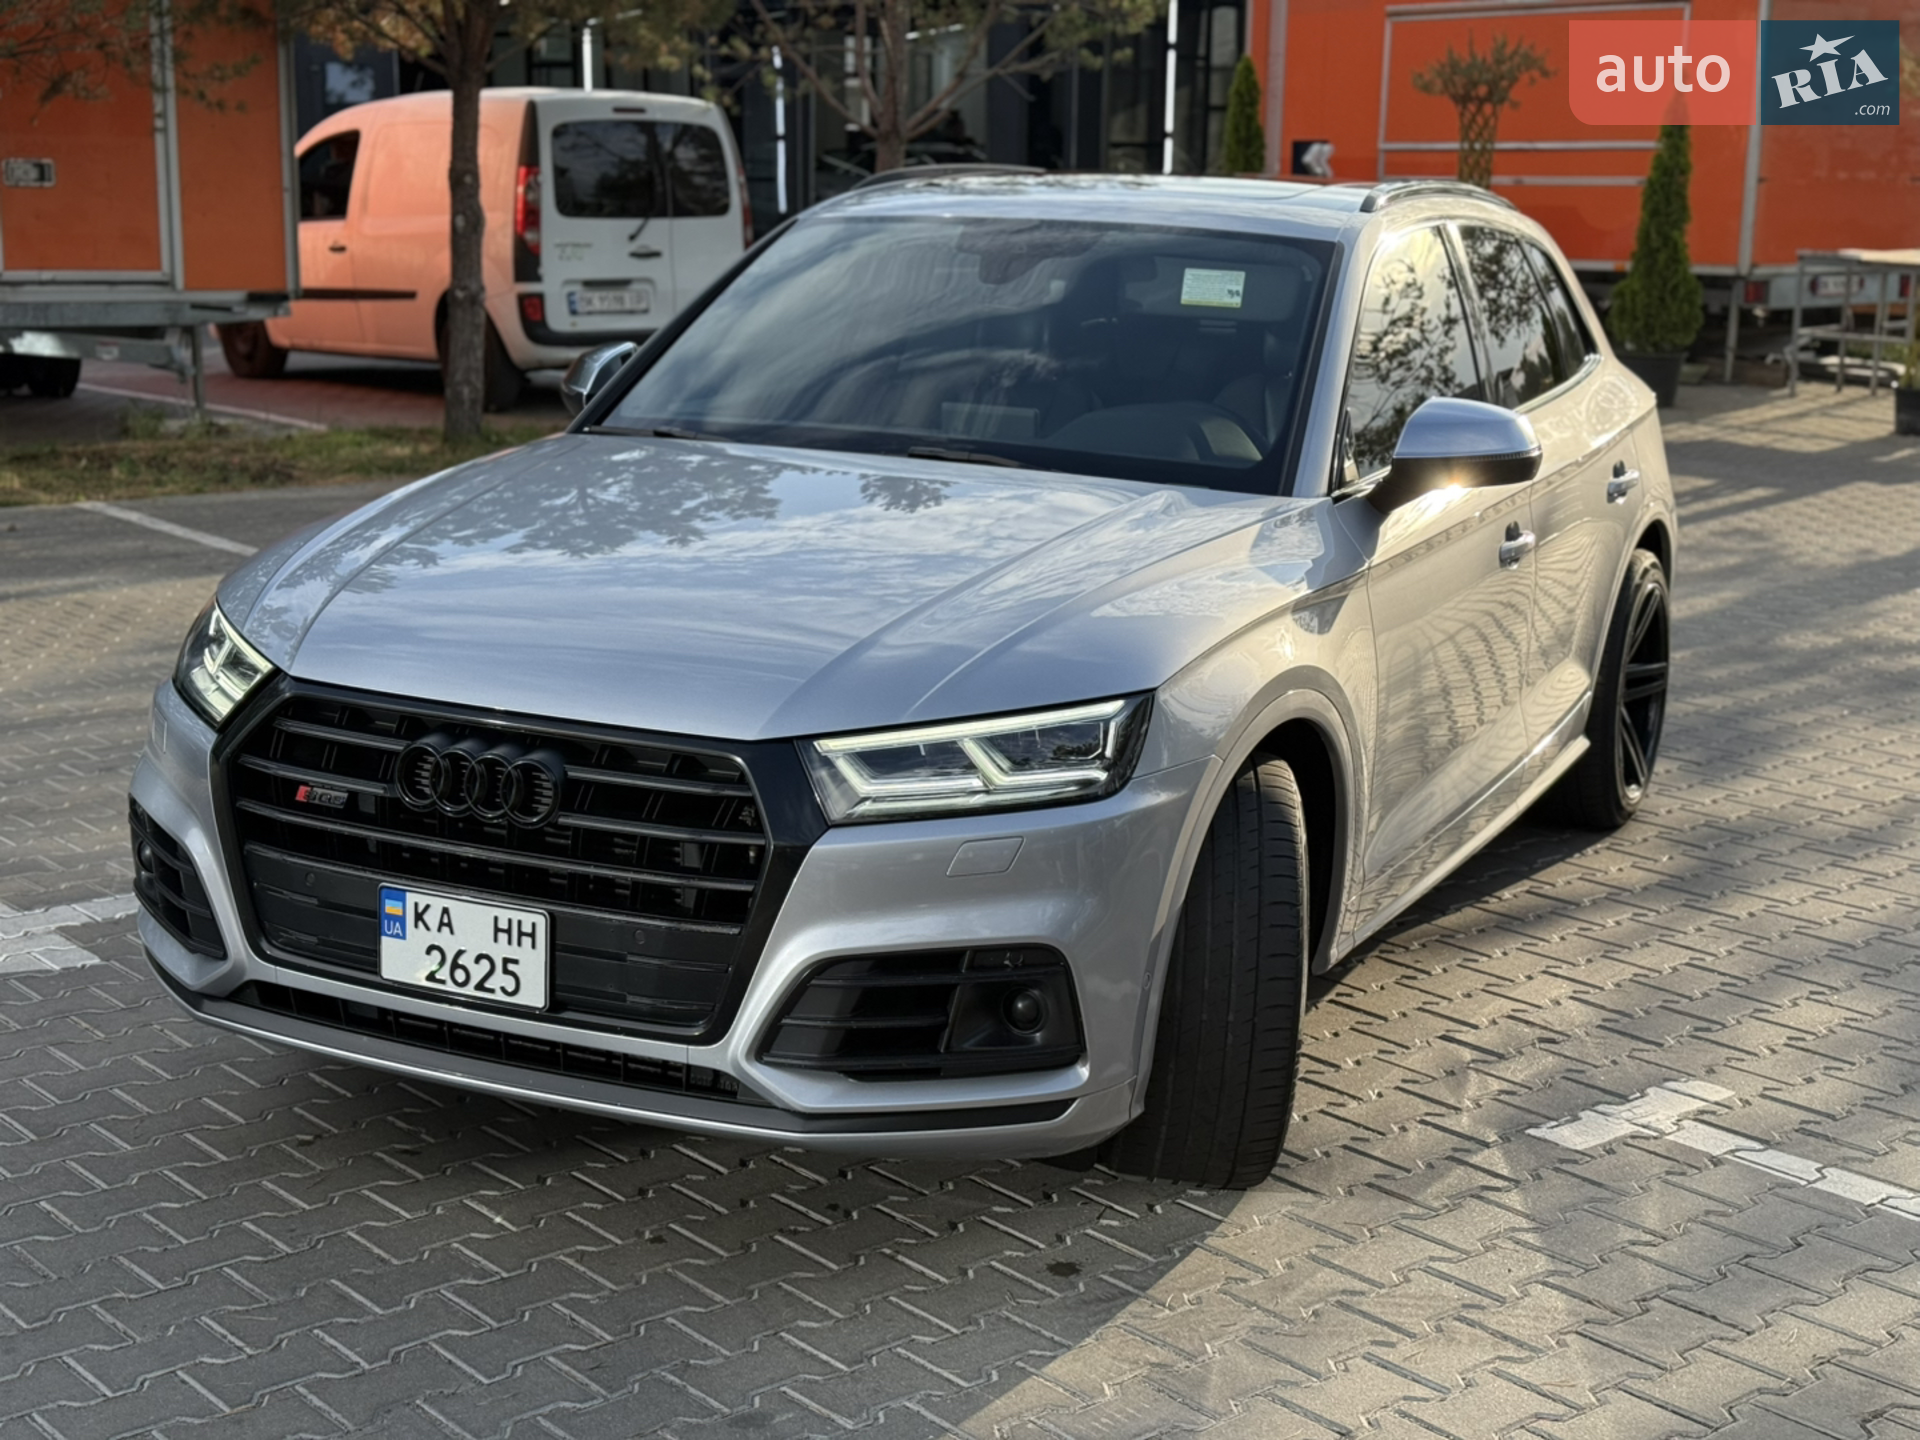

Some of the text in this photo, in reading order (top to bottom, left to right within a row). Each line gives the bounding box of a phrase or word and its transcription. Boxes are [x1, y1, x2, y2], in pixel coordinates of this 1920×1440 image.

[384, 919, 404, 937] UA
[413, 901, 537, 950] KA HH
[425, 943, 522, 998] 2625
